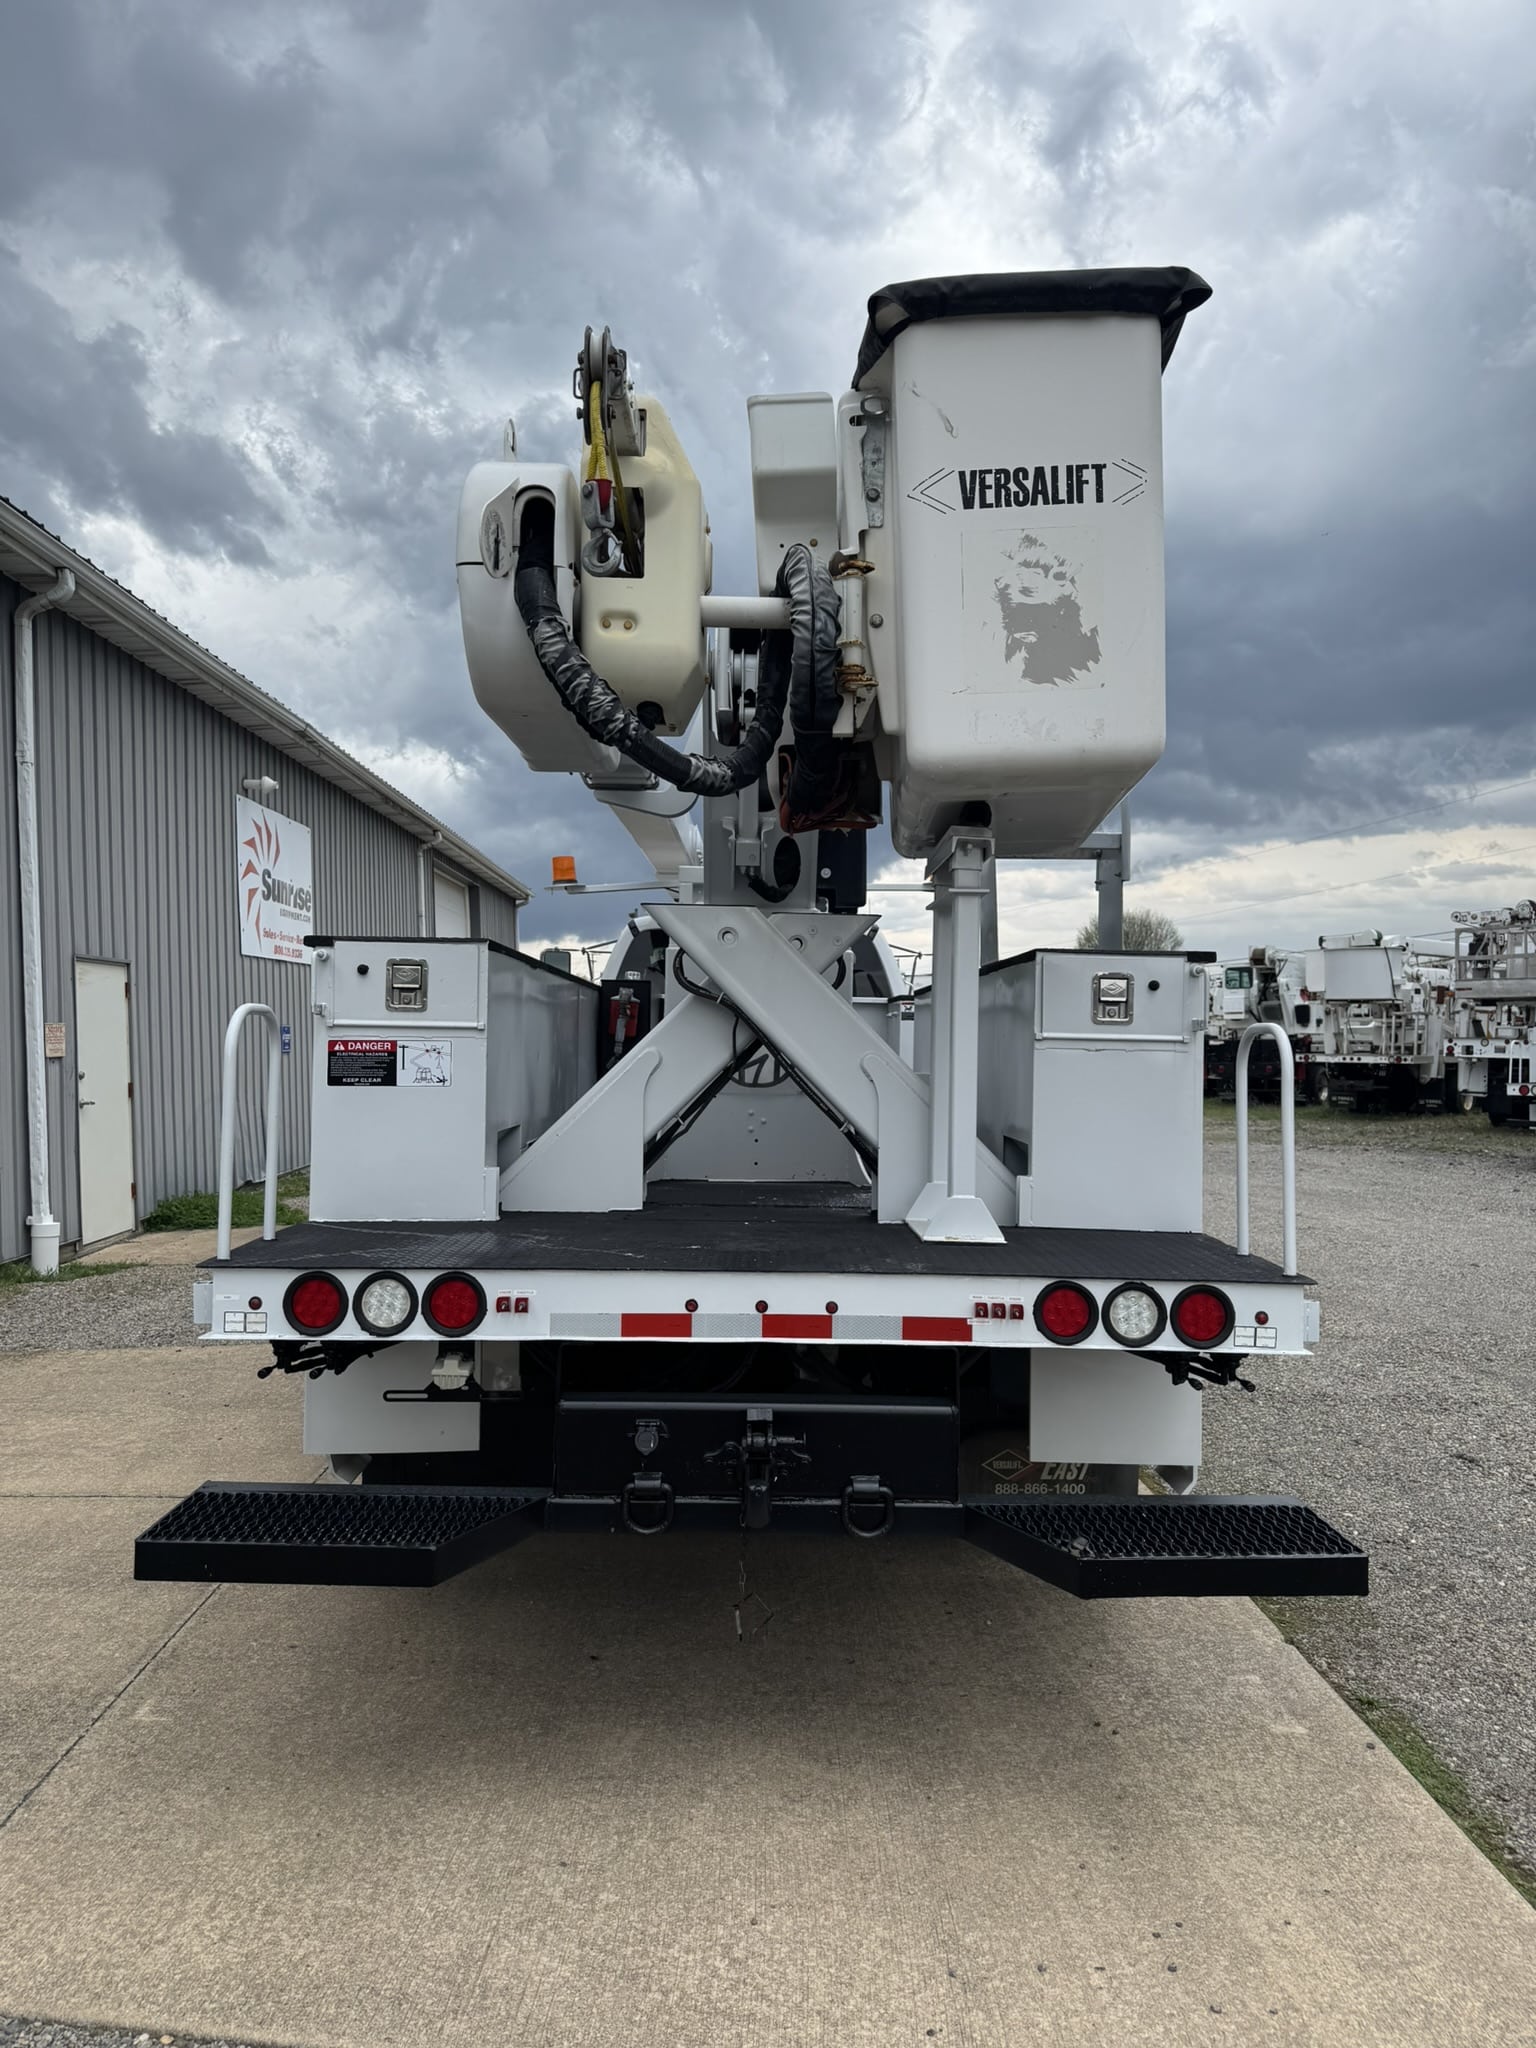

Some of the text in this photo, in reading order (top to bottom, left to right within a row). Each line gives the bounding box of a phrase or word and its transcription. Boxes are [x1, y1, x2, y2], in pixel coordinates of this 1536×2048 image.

[958, 463, 1107, 510] VERSALIFT
[262, 868, 311, 912] Sunrise
[348, 1042, 391, 1050] DANGER
[1040, 1462, 1089, 1480] EAST
[995, 1483, 1086, 1495] 888-866-1400
